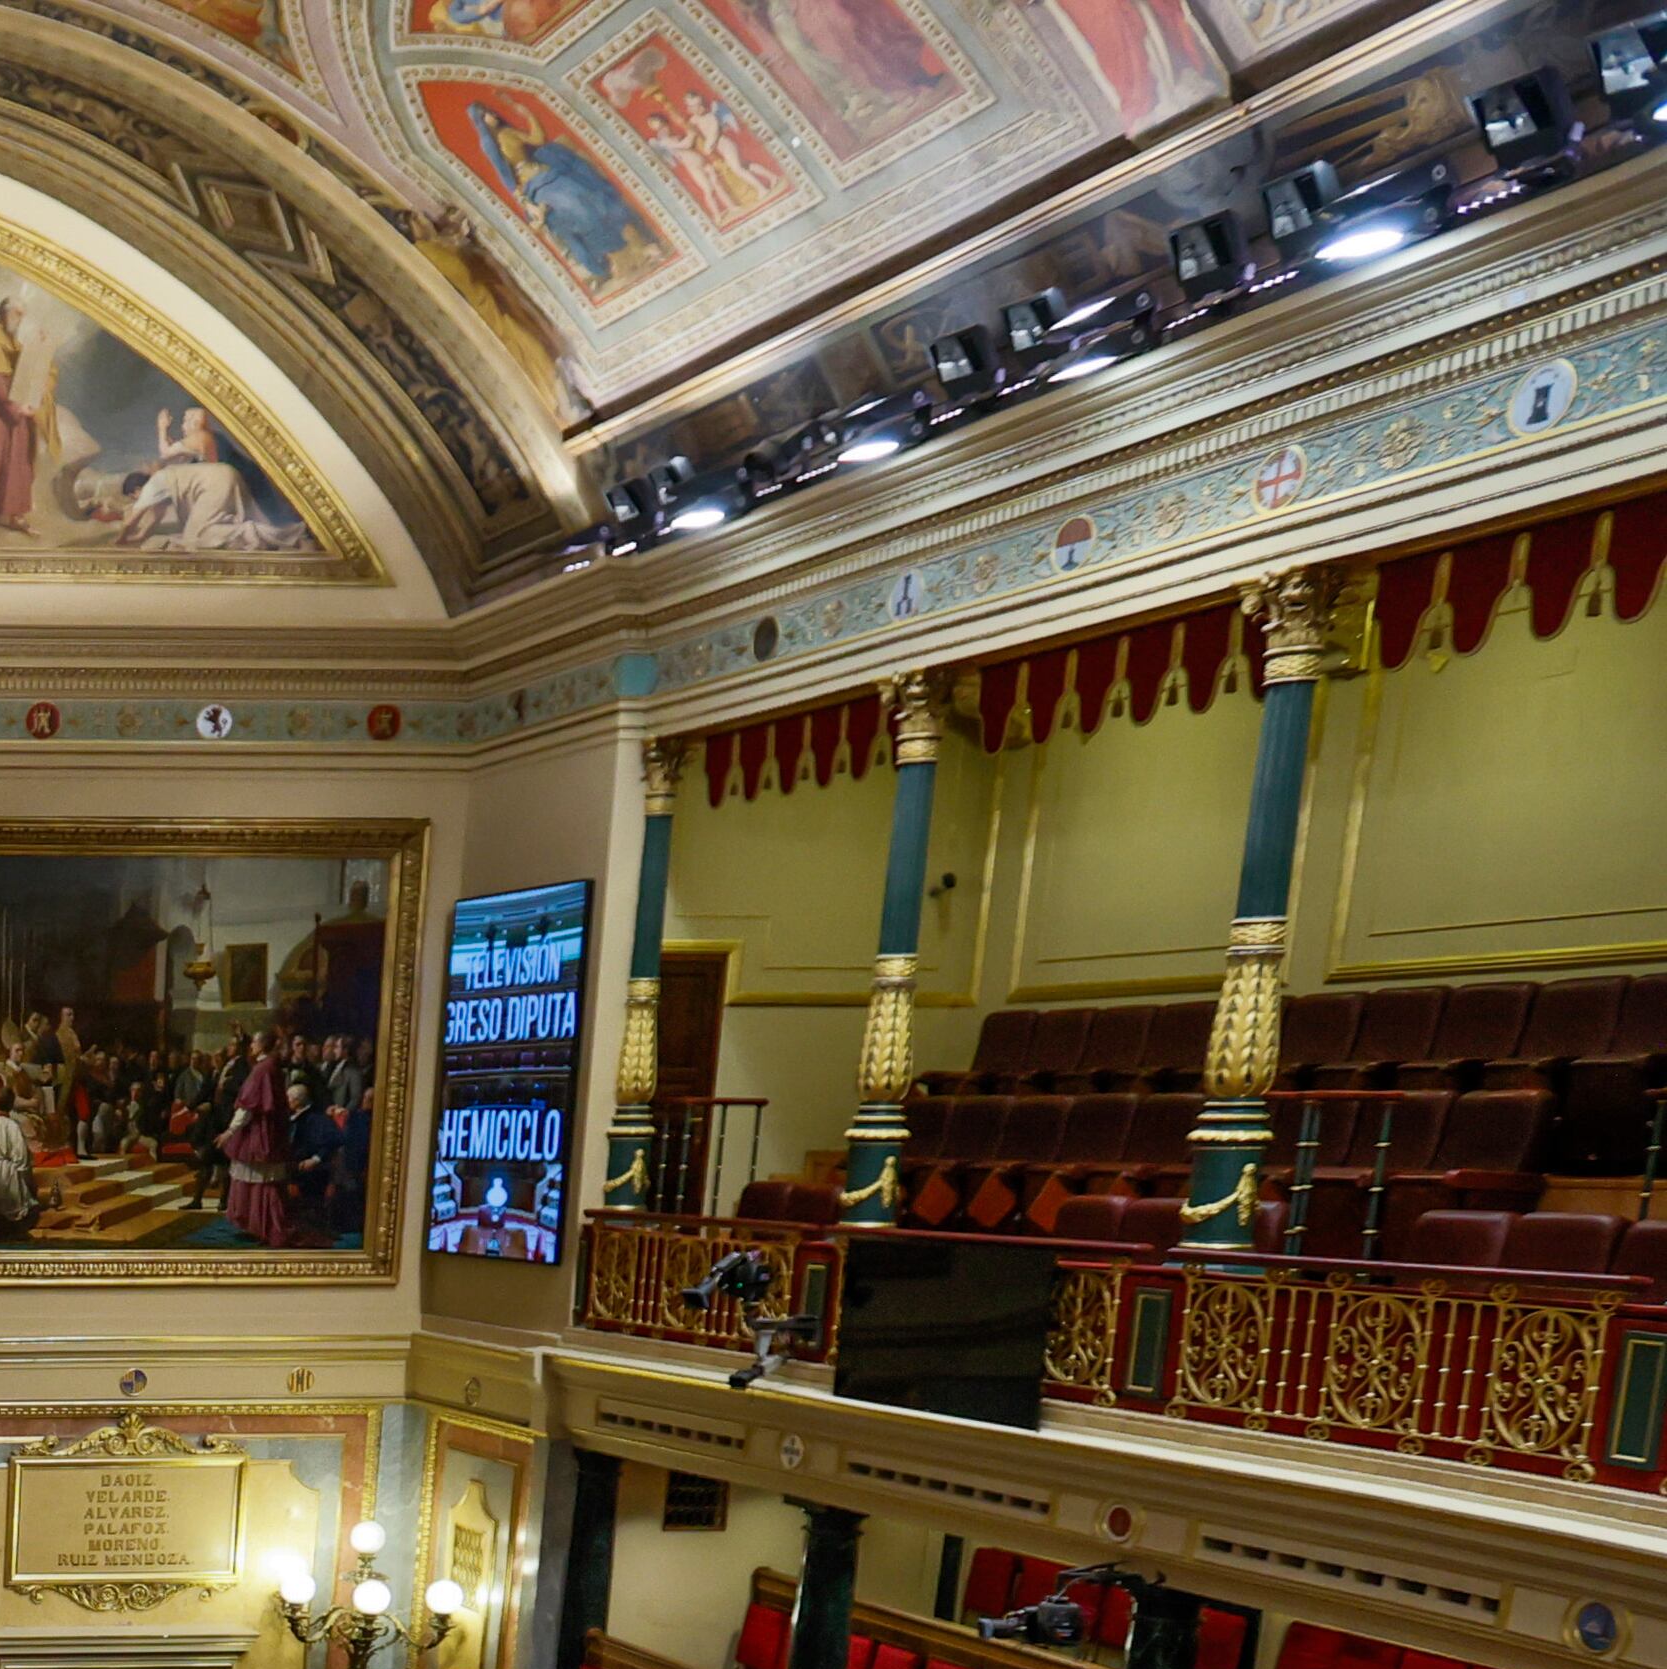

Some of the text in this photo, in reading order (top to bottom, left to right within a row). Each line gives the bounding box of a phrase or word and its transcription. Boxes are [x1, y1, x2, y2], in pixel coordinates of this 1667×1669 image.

[465, 939, 561, 991] TELEVISIÓN
[505, 991, 577, 1042] DIPUTA
[441, 1108, 562, 1161] HEMICICLO
[57, 1554, 98, 1566] RUIZ
